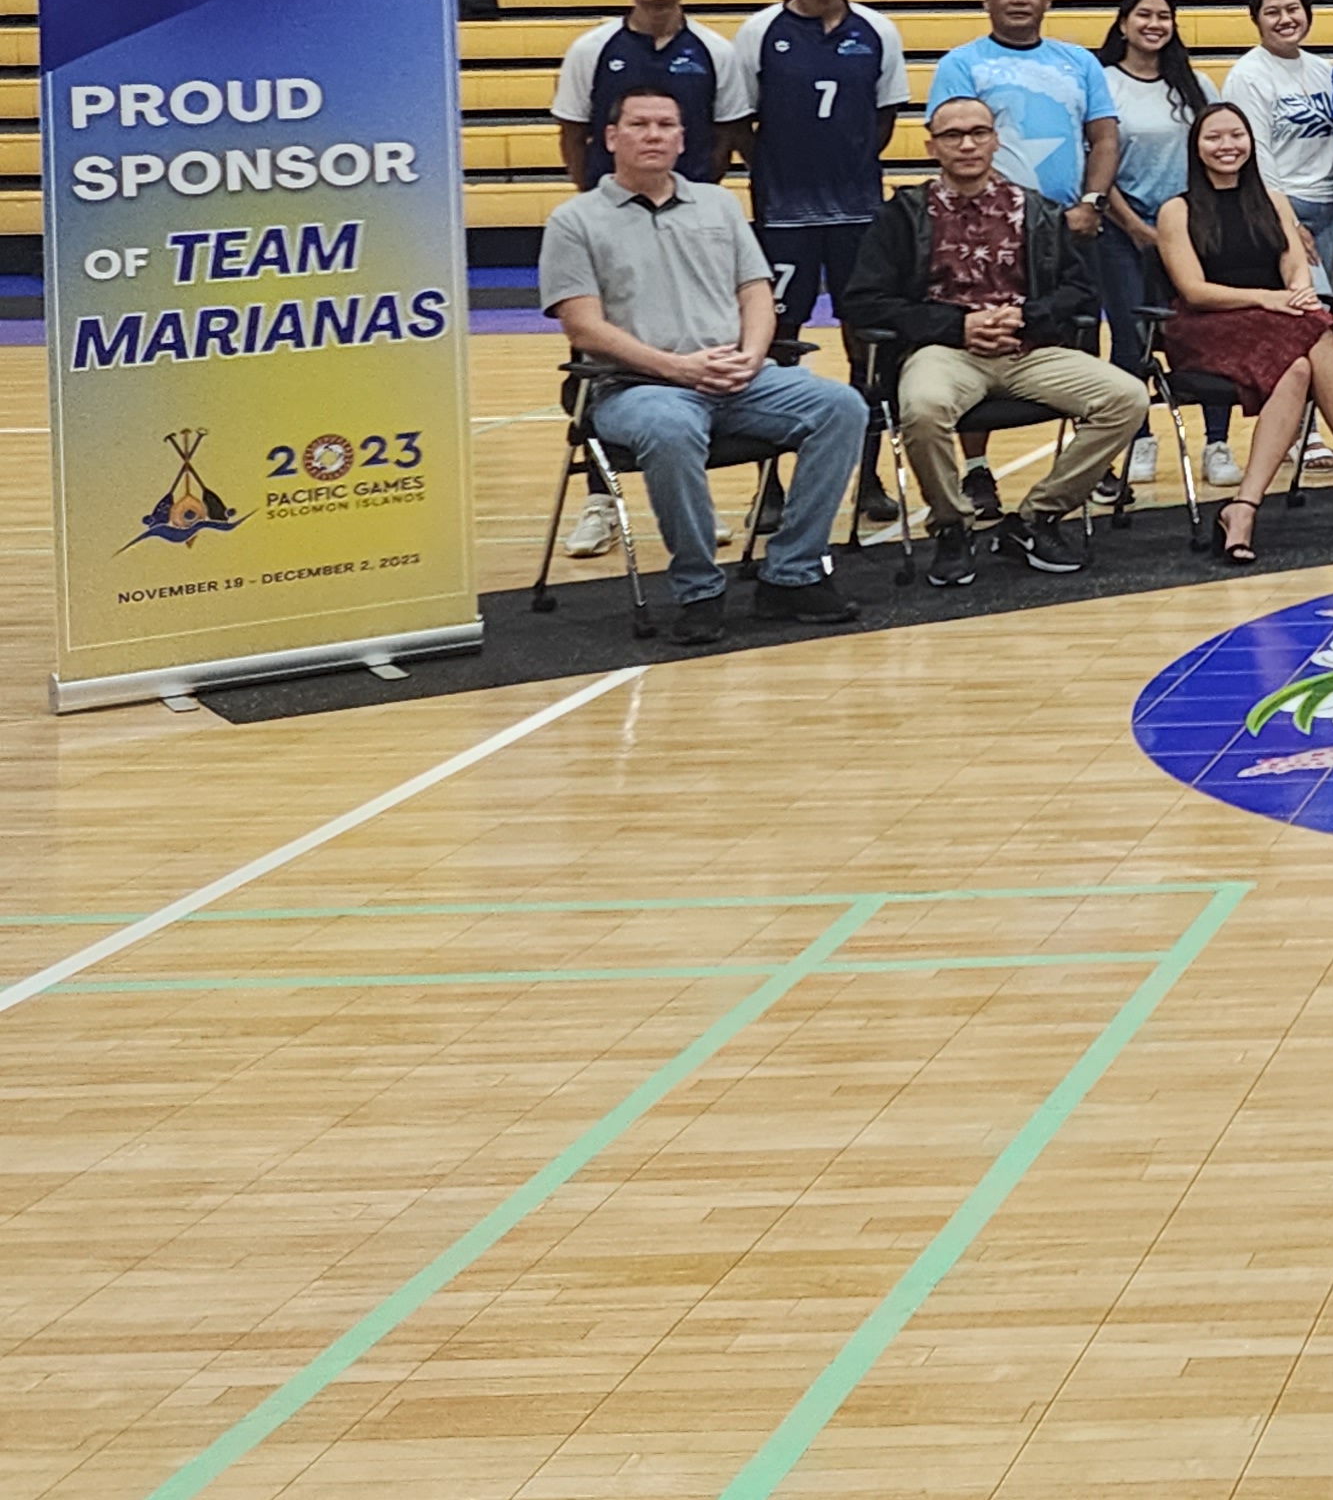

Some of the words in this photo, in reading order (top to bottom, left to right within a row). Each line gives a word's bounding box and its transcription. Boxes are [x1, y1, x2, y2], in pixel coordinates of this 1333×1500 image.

[70, 77, 324, 130] PROUD
[814, 80, 838, 119] 7
[72, 141, 420, 202] SPONSOR
[84, 247, 150, 280] OF
[167, 220, 366, 285] TEAM
[773, 263, 796, 299] 7
[70, 288, 449, 372] MARIANAS
[266, 431, 423, 482] 2023
[266, 501, 349, 519] SOLOMON
[267, 484, 349, 506] PACIFIC
[353, 475, 425, 496] GAMES
[117, 580, 219, 604] NOVEMBER
[262, 562, 355, 585] DECEMBER
